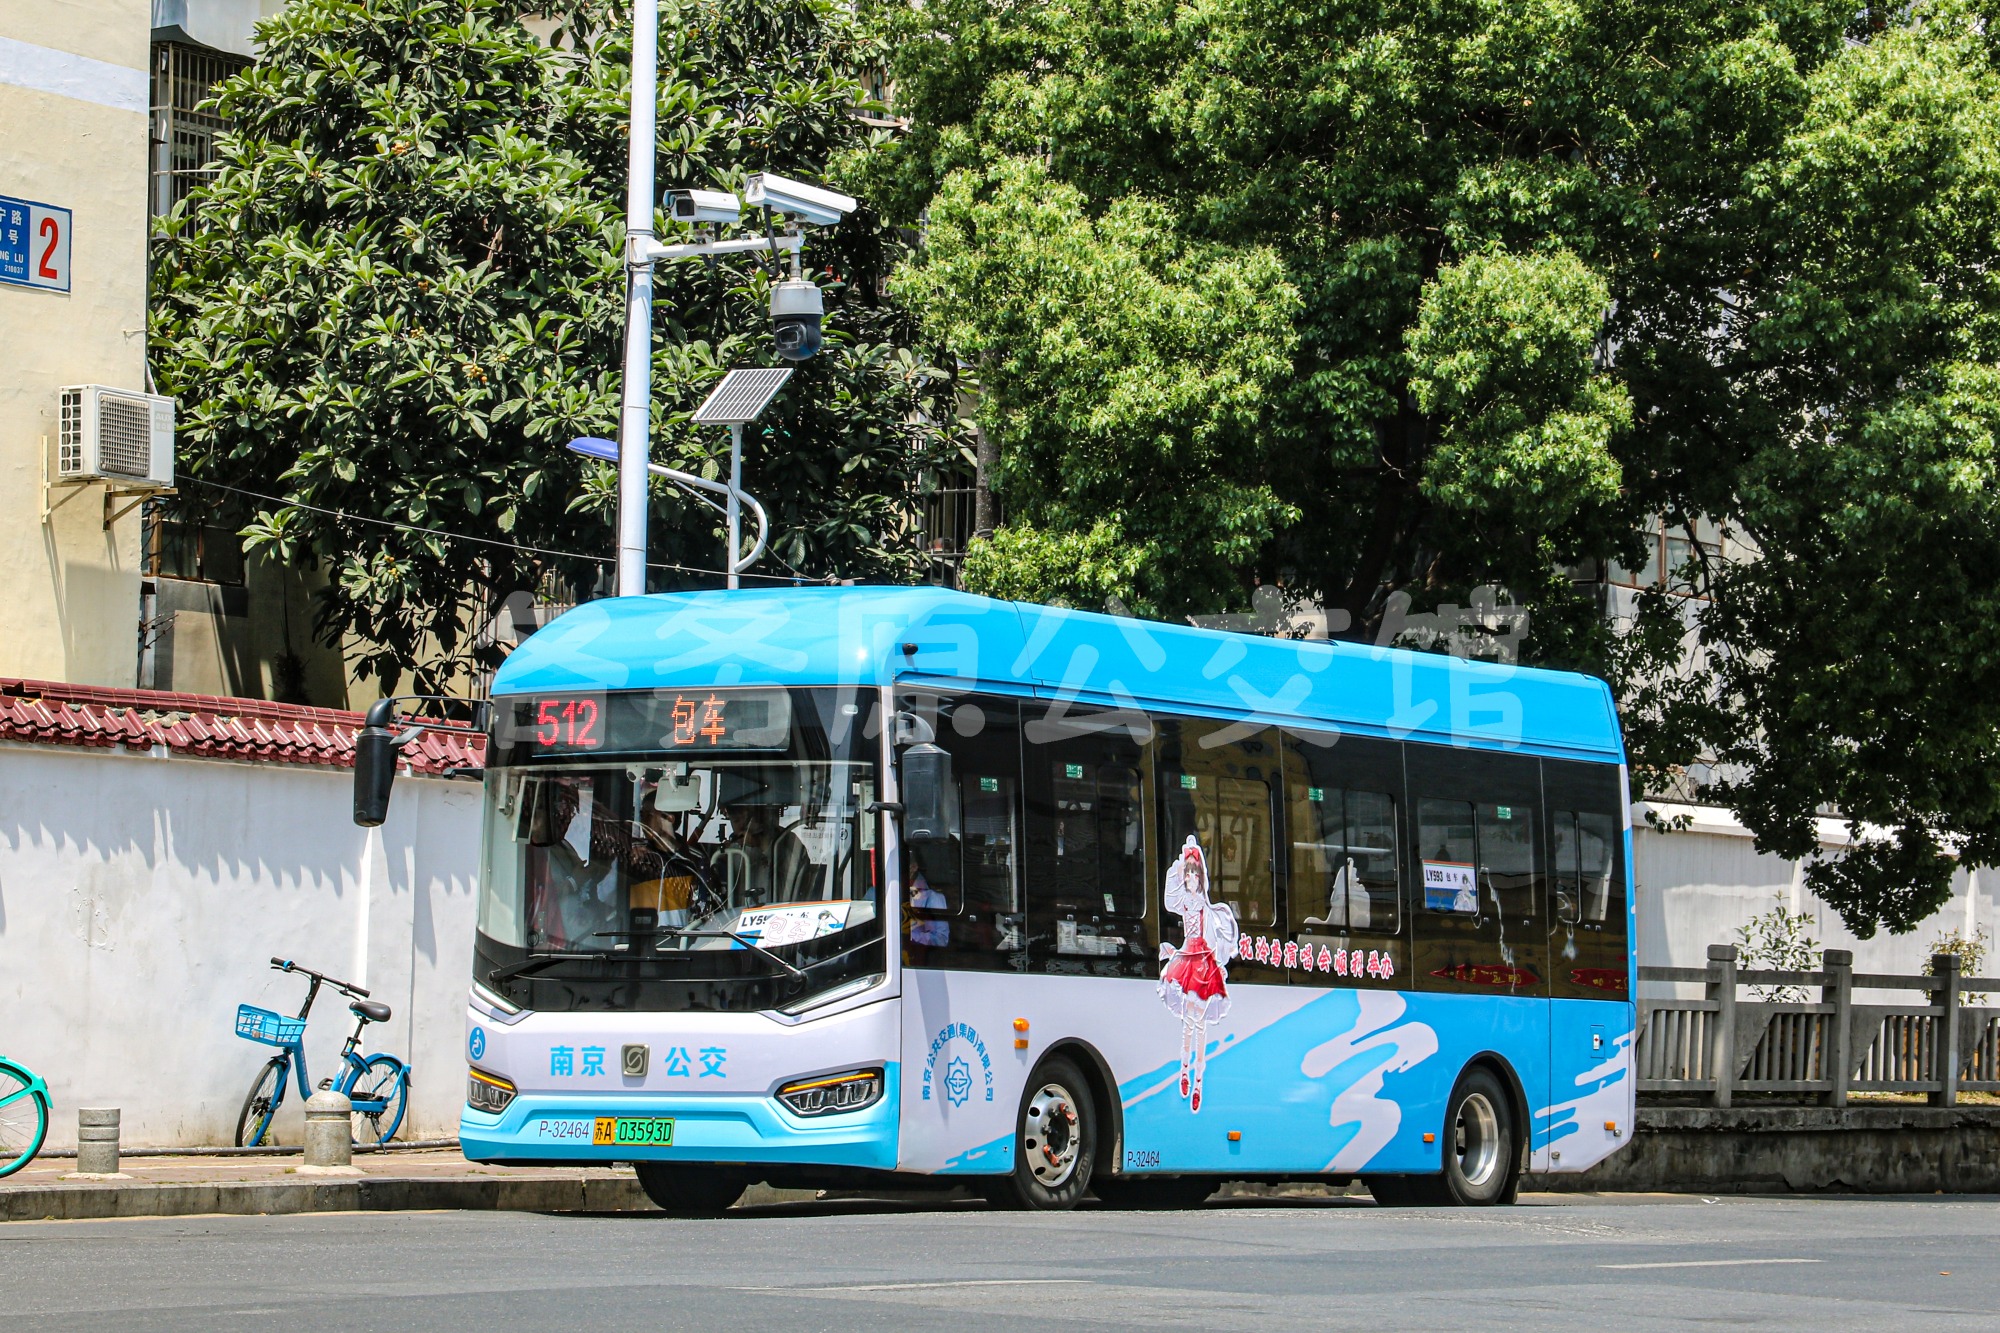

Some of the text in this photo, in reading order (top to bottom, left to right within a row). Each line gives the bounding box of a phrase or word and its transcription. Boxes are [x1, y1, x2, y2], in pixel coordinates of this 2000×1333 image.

[14, 253, 24, 264] LU
[39, 217, 59, 280] 2
[537, 699, 599, 747] 512
[671, 693, 726, 746] 包车
[1425, 869, 1444, 883] LY593
[550, 1045, 728, 1079] 南京 公交
[538, 1120, 590, 1139] P-32464
[1126, 1150, 1161, 1169] P-32464
